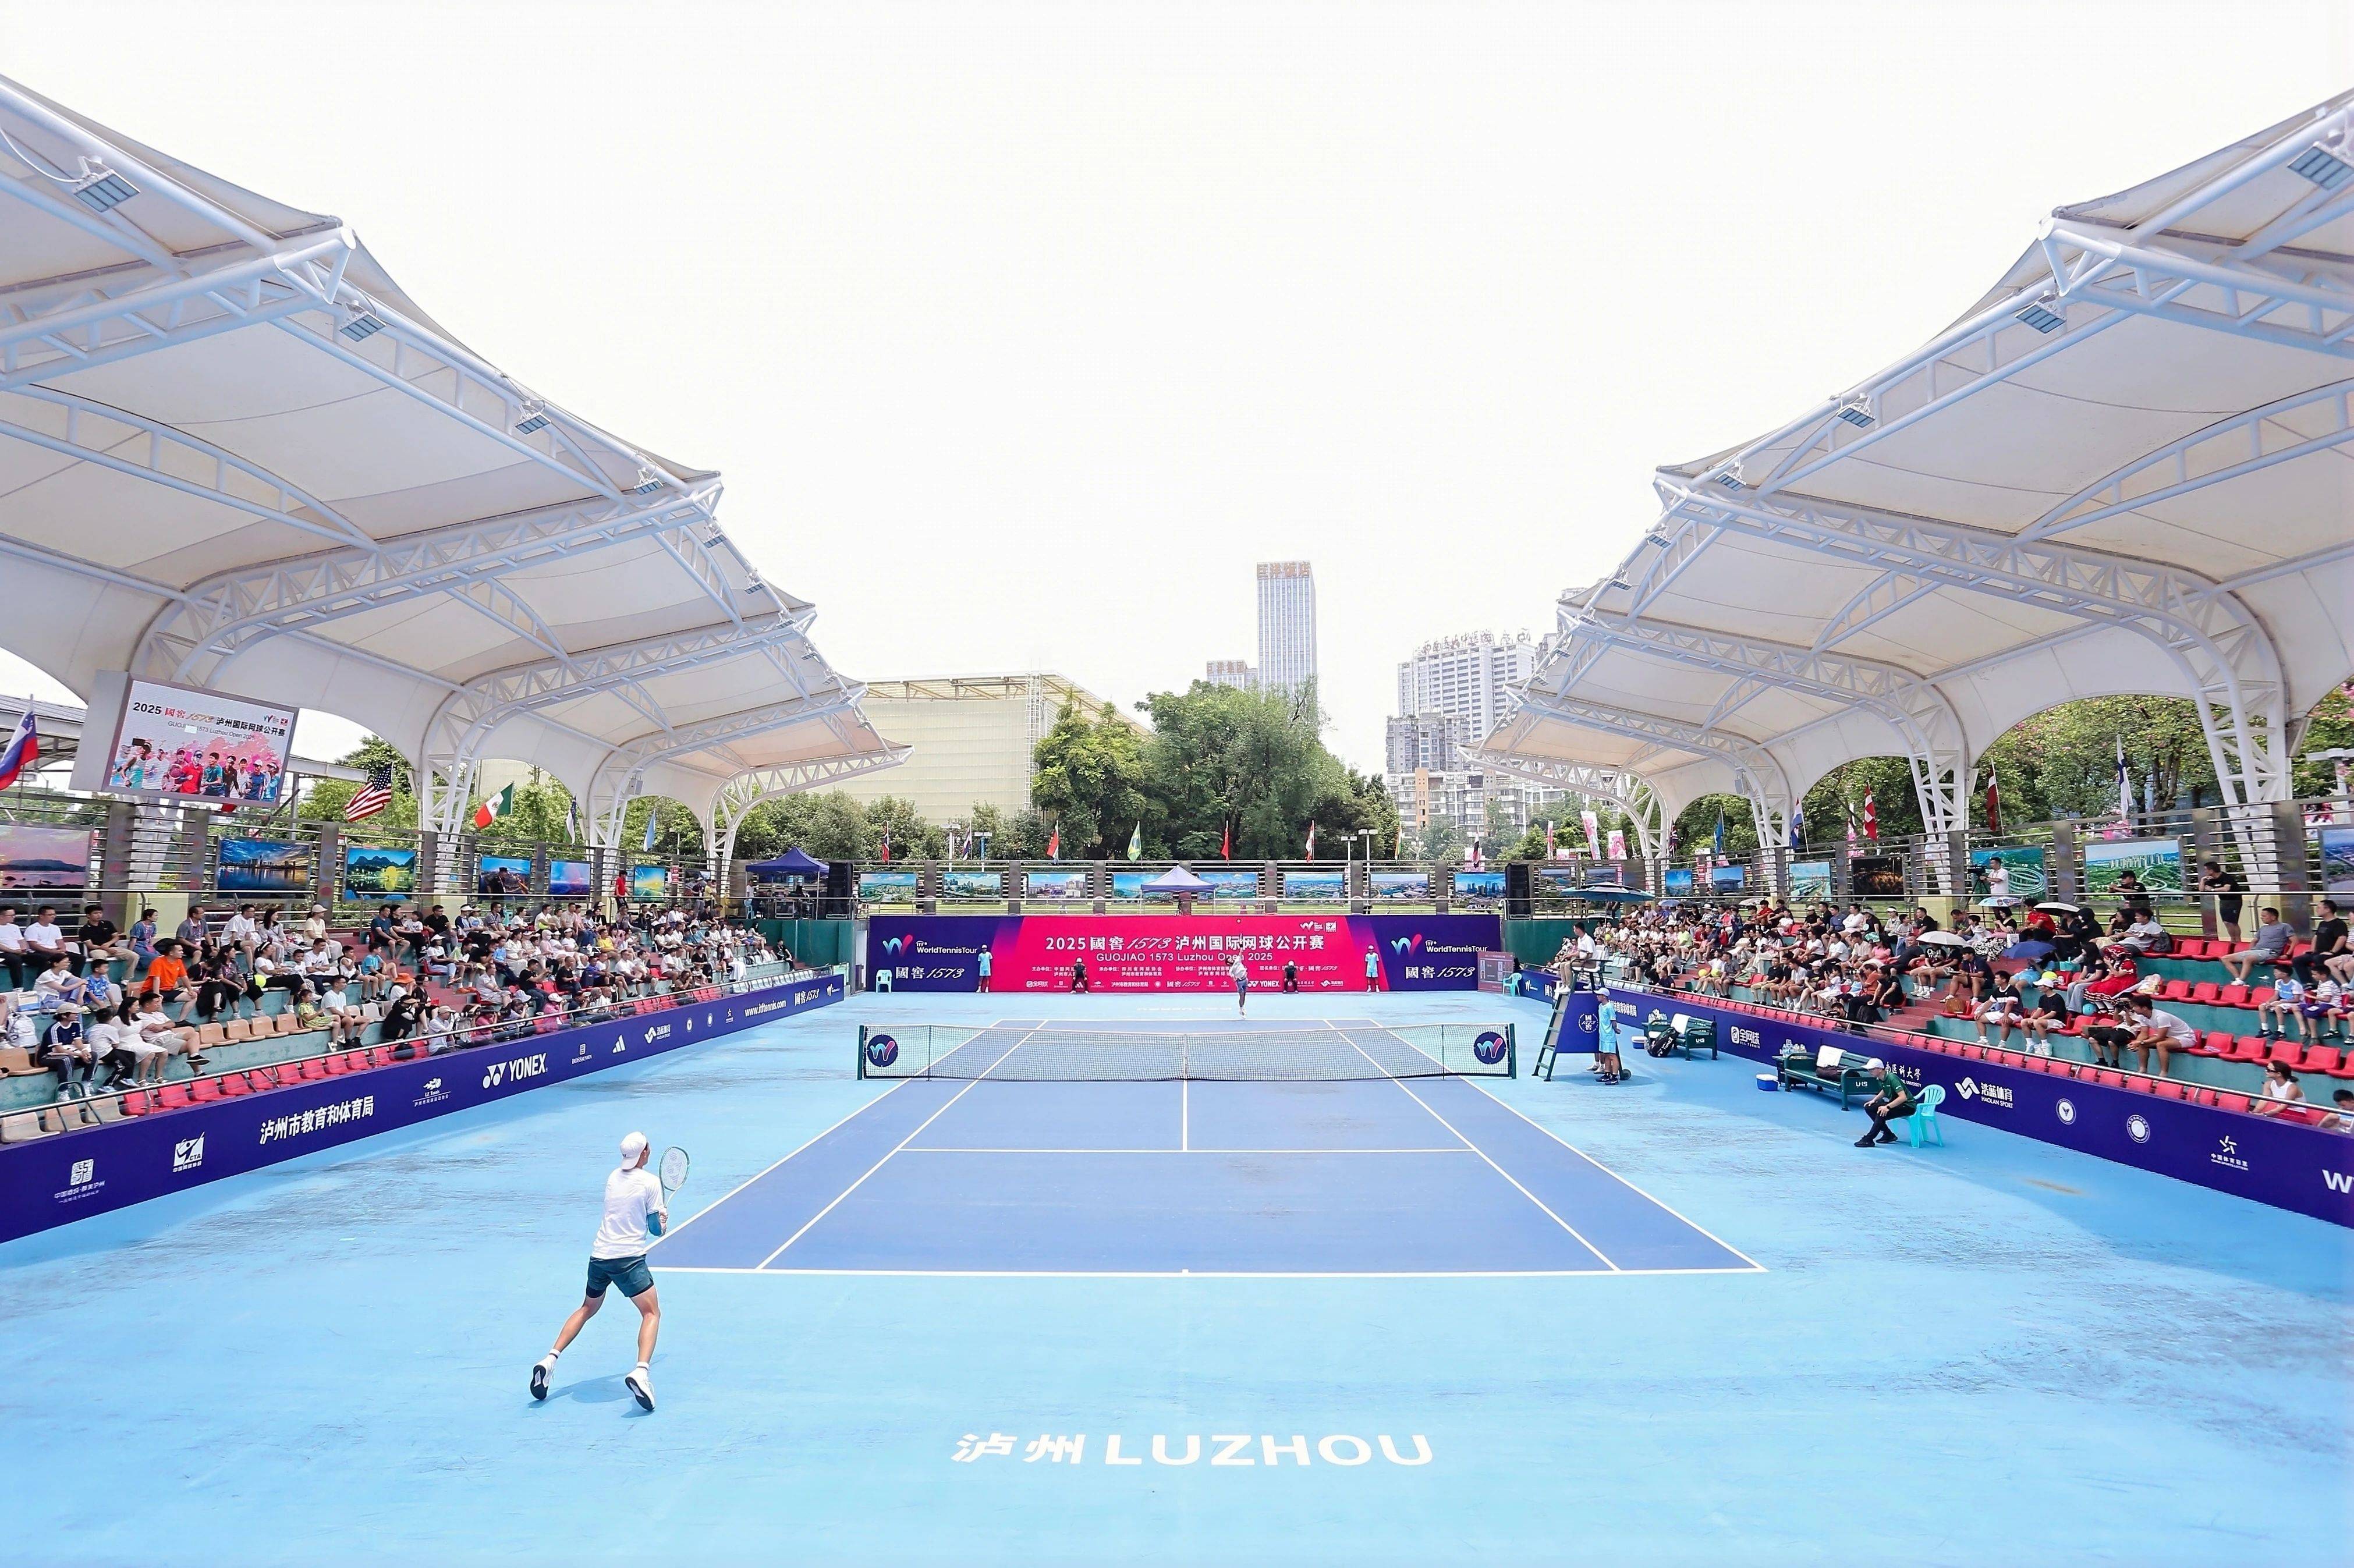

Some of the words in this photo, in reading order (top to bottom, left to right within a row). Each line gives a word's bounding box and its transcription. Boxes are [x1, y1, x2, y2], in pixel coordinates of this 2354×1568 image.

[133, 702, 162, 715] 2025
[216, 716, 285, 737] 泸州国际网球公开赛
[1046, 937, 1086, 950] 2025
[1090, 936, 1125, 950] 國窖
[1126, 937, 1172, 950] 1573
[1175, 935, 1324, 951] 泸州国际网球公开赛
[1096, 953, 1146, 962] GUOJIAO
[1150, 953, 1174, 962] 1573
[1178, 952, 1214, 962] Luzhou
[1248, 953, 1273, 961] 2025
[926, 968, 965, 978] 1573
[1437, 967, 1476, 978] 1573
[806, 988, 820, 1002] 1573
[745, 999, 786, 1017] www.itftennis.com
[1739, 1028, 1760, 1045] 全网球
[509, 1052, 547, 1081] YONEX
[1885, 1061, 1922, 1081] 南医科大學
[1981, 1082, 2013, 1102] 浩蓝体育
[1981, 1096, 2000, 1105] HAOLAN
[2000, 1100, 2013, 1109] SPORT
[260, 1095, 374, 1145] 泸州市教育和体育局
[2211, 1153, 2248, 1167] 中国体育彩票
[951, 1432, 1087, 1466] 泸州
[1105, 1434, 1434, 1466] LUZHOU
